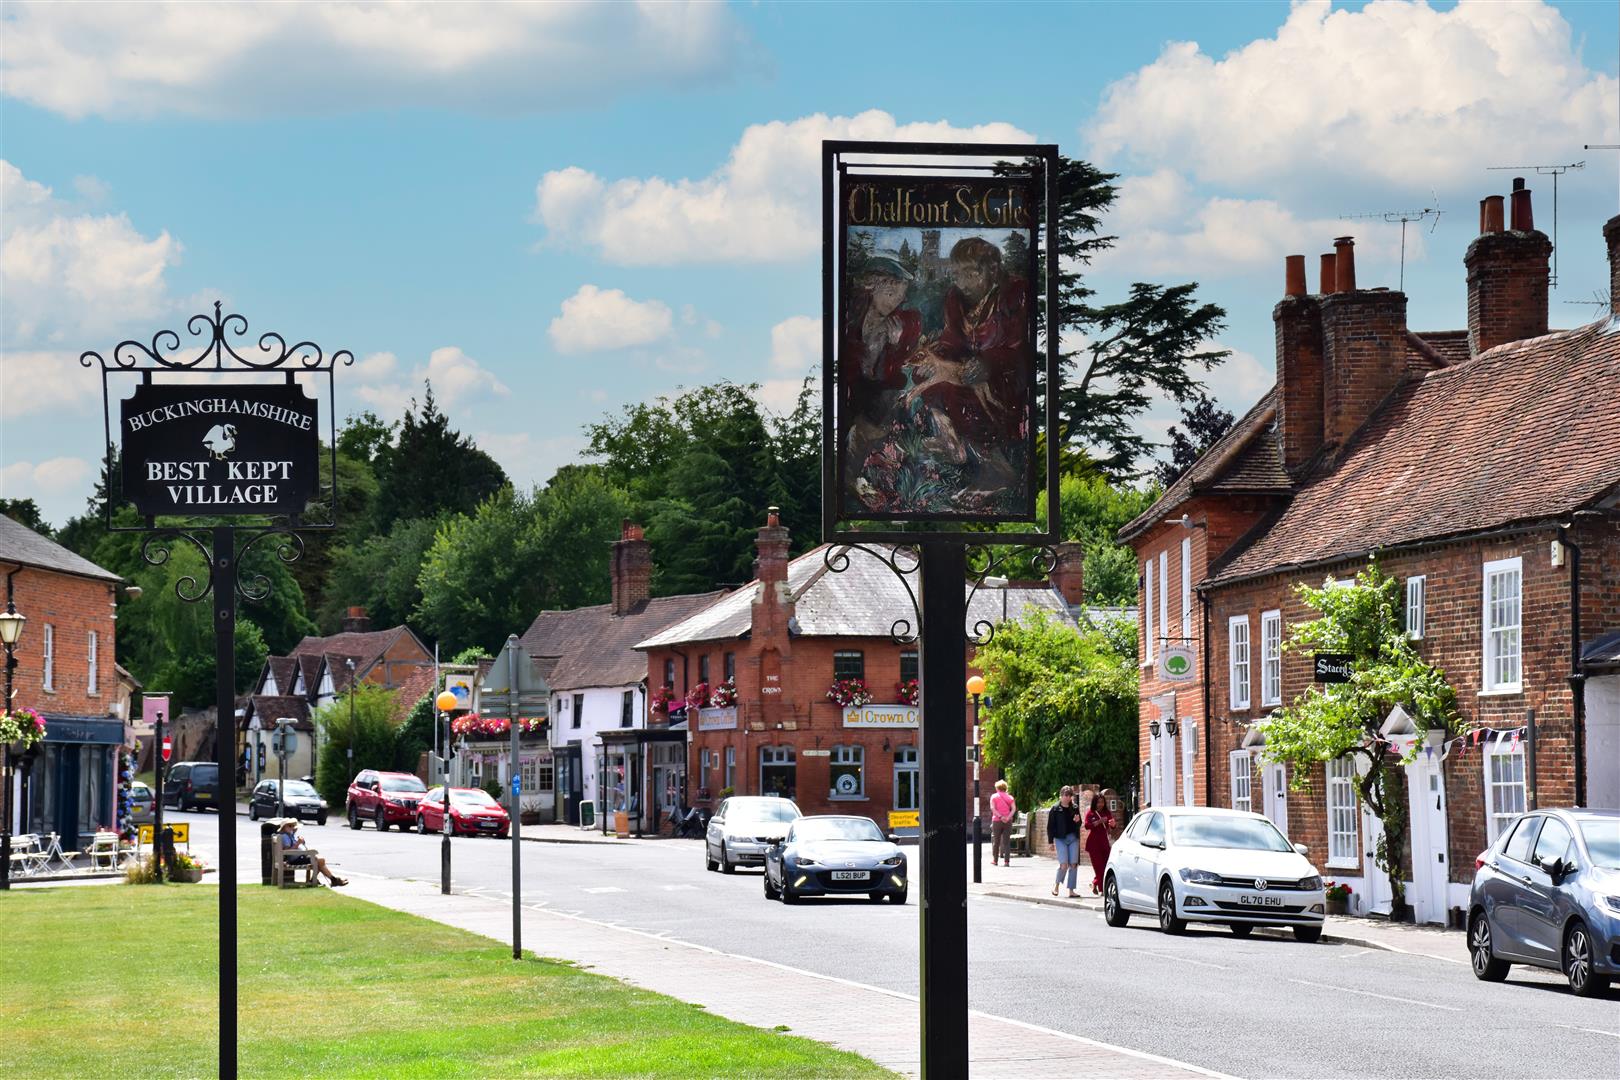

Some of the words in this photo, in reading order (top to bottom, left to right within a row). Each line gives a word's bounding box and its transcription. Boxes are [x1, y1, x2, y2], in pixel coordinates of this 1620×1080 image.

[849, 187, 949, 224] Chalfont
[127, 398, 313, 432] BUCKINGHAMSHIRE
[146, 461, 210, 481] BEST
[227, 461, 293, 480] KEPT
[167, 485, 278, 504] VILLAGE
[865, 710, 904, 723] Crown
[1240, 895, 1263, 905] GL70
[1264, 896, 1281, 906] EHU
